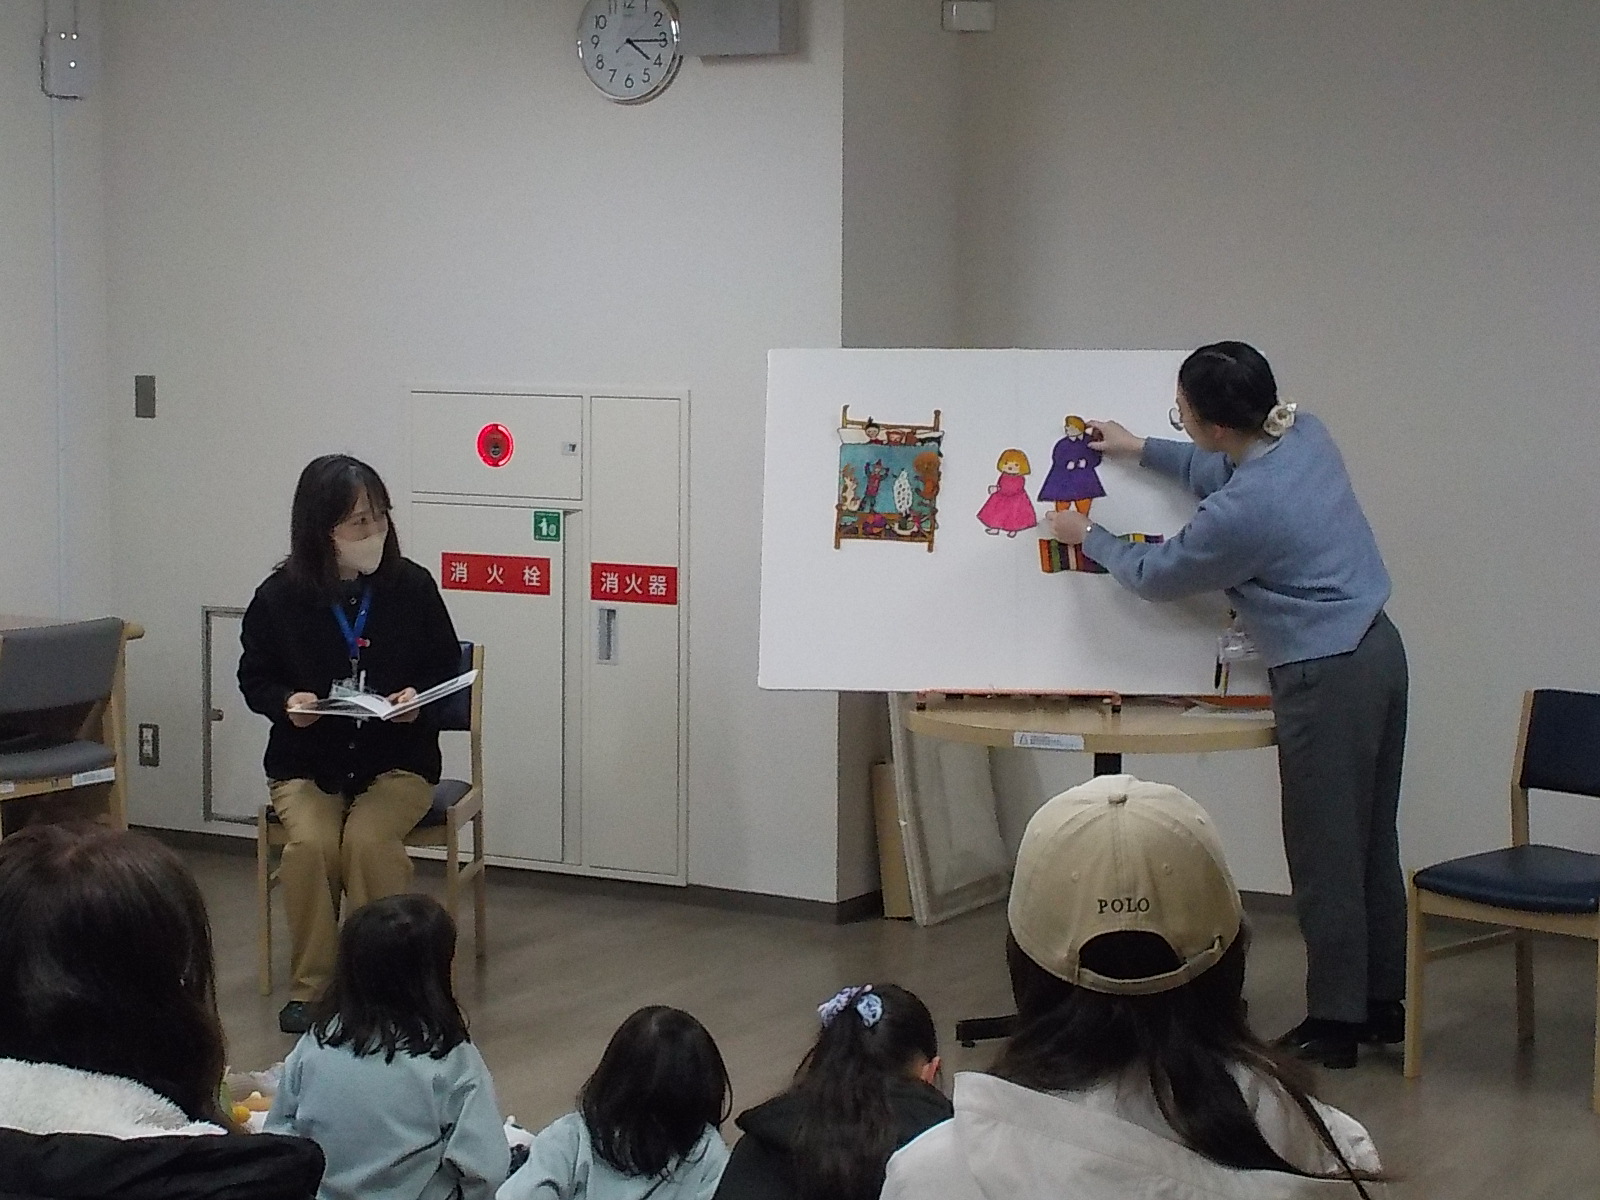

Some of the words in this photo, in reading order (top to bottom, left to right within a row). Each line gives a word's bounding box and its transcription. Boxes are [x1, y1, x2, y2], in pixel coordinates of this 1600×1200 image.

[595, 14, 607, 30] 10
[653, 11, 663, 27] 2
[591, 35, 600, 49] 9
[658, 31, 668, 48] 3
[595, 54, 604, 70] 8
[653, 53, 663, 68] 4
[609, 69, 617, 82] 7
[624, 73, 634, 89] 6
[641, 67, 651, 83] 5
[450, 561, 541, 587] 消火栓
[600, 571, 667, 596] 消火器
[1097, 897, 1150, 914] POLO
